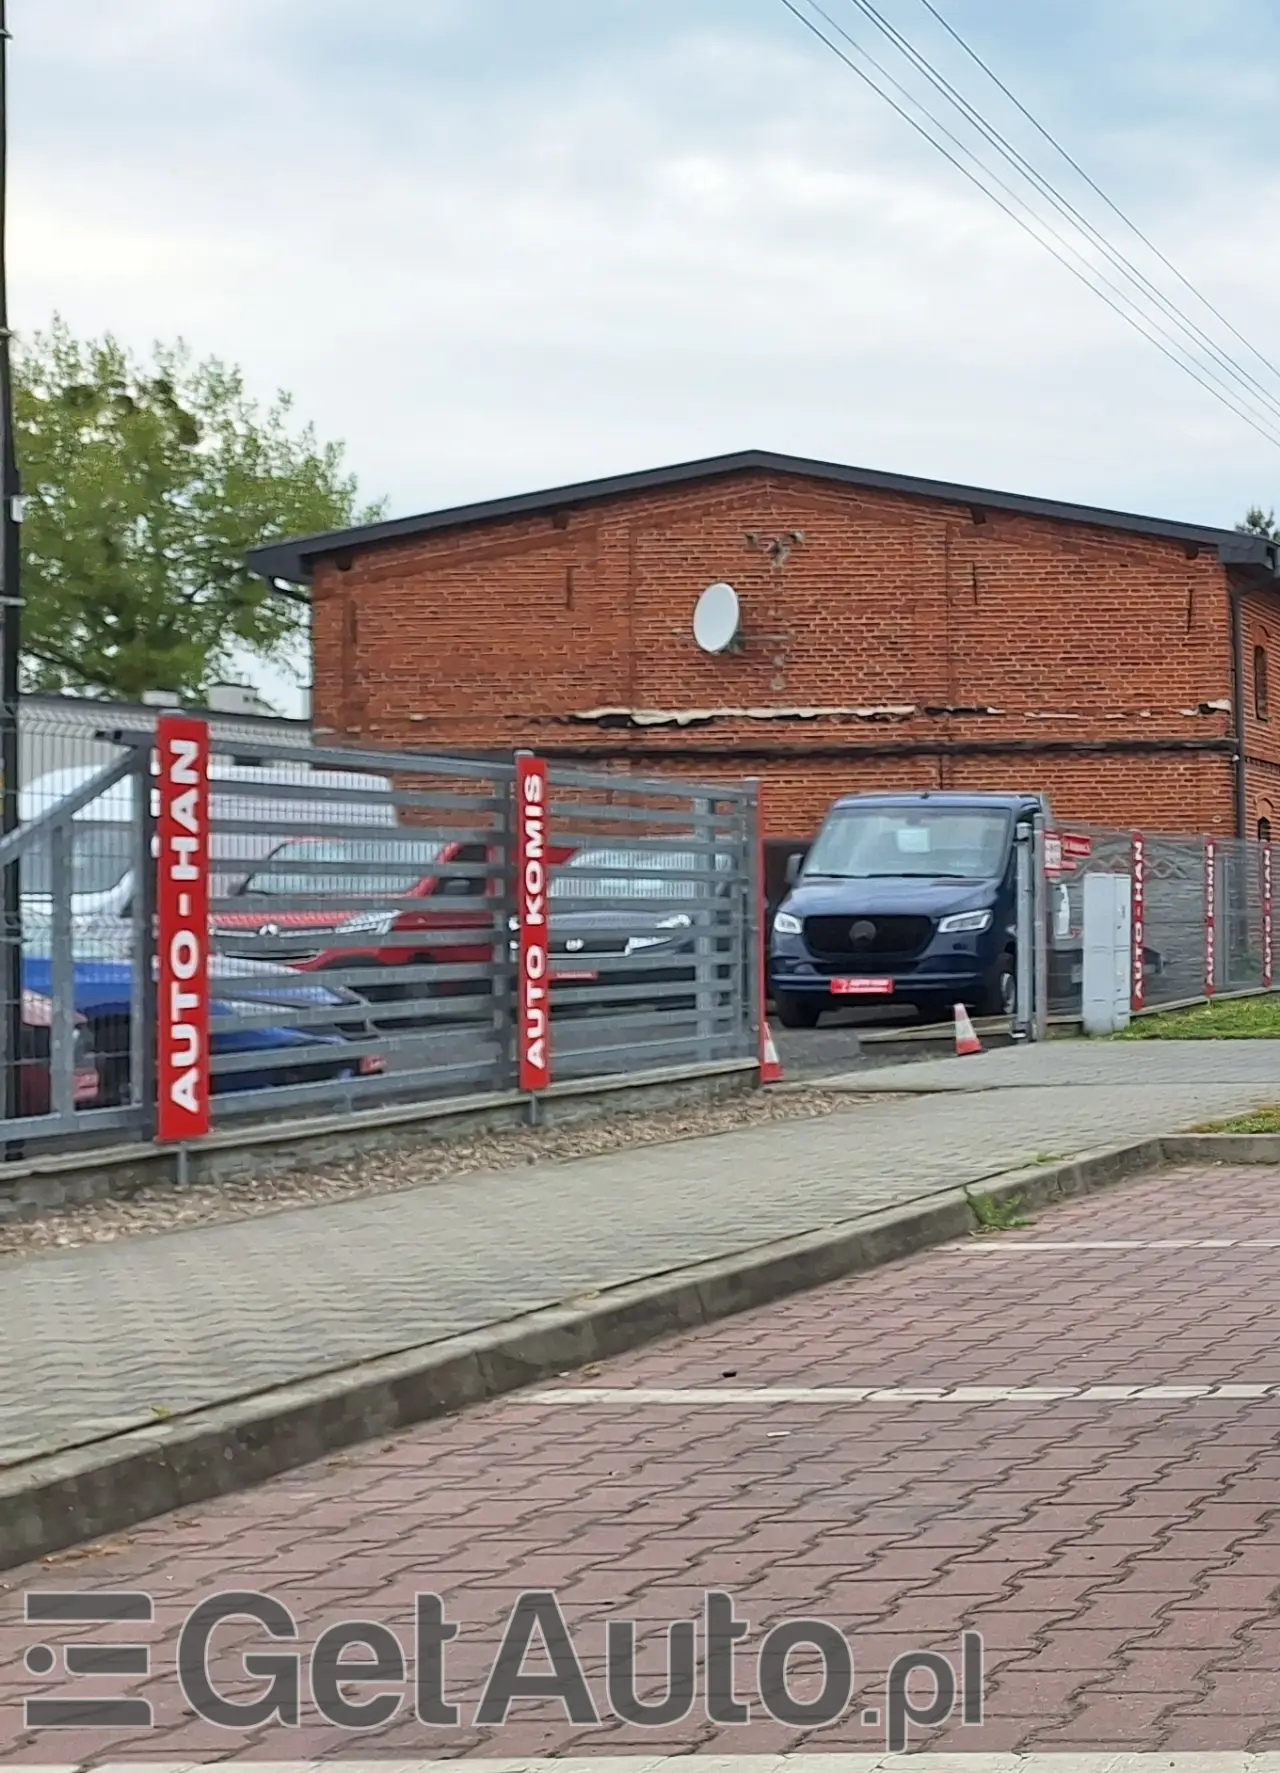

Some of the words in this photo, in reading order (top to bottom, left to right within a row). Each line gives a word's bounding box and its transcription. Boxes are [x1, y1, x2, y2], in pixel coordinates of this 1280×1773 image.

[524, 774, 544, 925] KOMIS
[1206, 844, 1215, 917] KOMIS
[1206, 926, 1215, 986] AUTO
[526, 944, 545, 1070] AUTO
